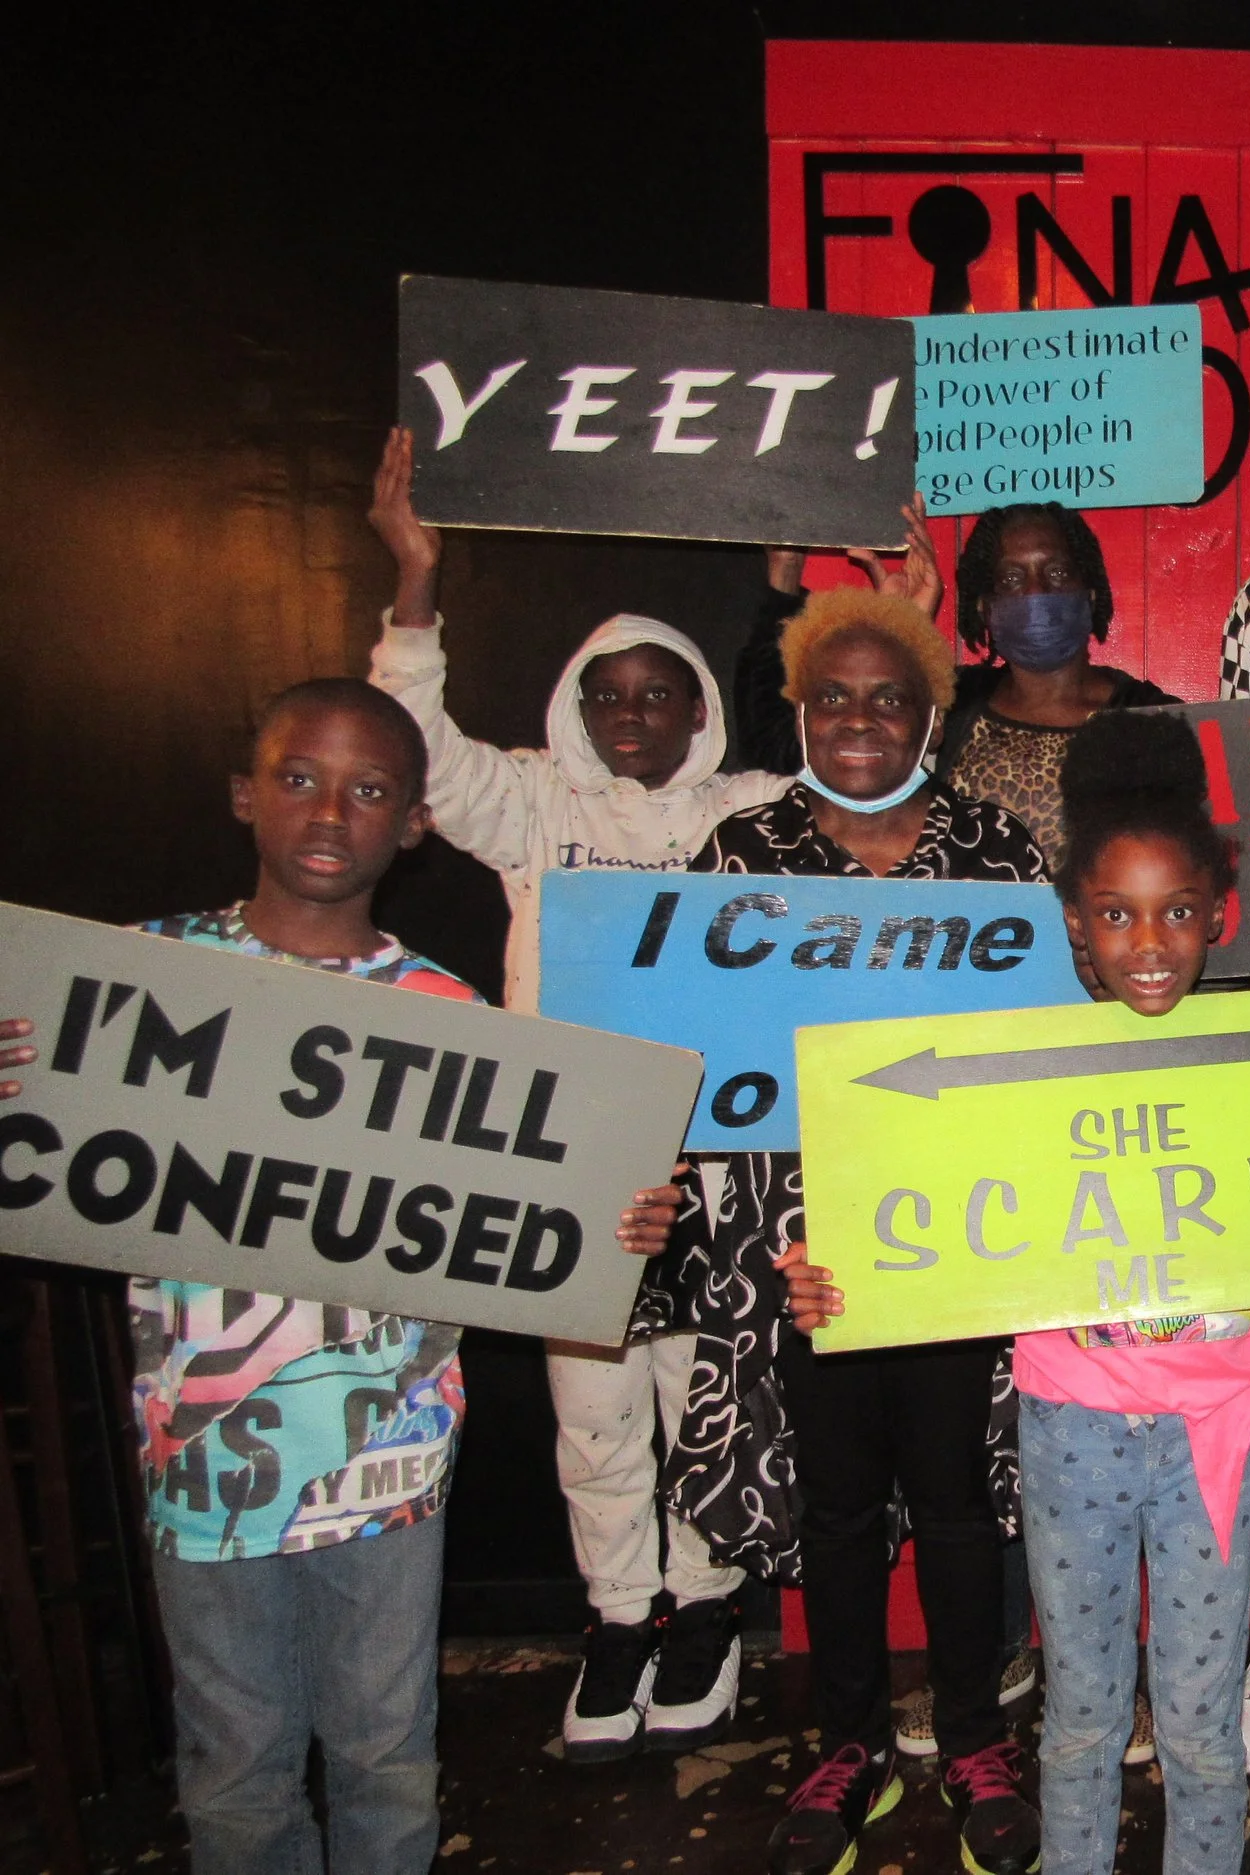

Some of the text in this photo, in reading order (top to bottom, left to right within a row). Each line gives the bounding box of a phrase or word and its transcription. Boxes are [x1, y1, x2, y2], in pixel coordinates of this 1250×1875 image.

[938, 379, 1060, 409] Power
[1071, 369, 1112, 401] of
[915, 414, 1132, 461] pid People in
[984, 462, 1116, 497] Groups
[559, 842, 693, 872] Champi
[631, 892, 1035, 972] I Came
[50, 975, 569, 1164] I'M STILL
[1070, 1103, 1191, 1160] SHE
[0, 1112, 584, 1293] CONFUSED
[1096, 1252, 1193, 1311] ME
